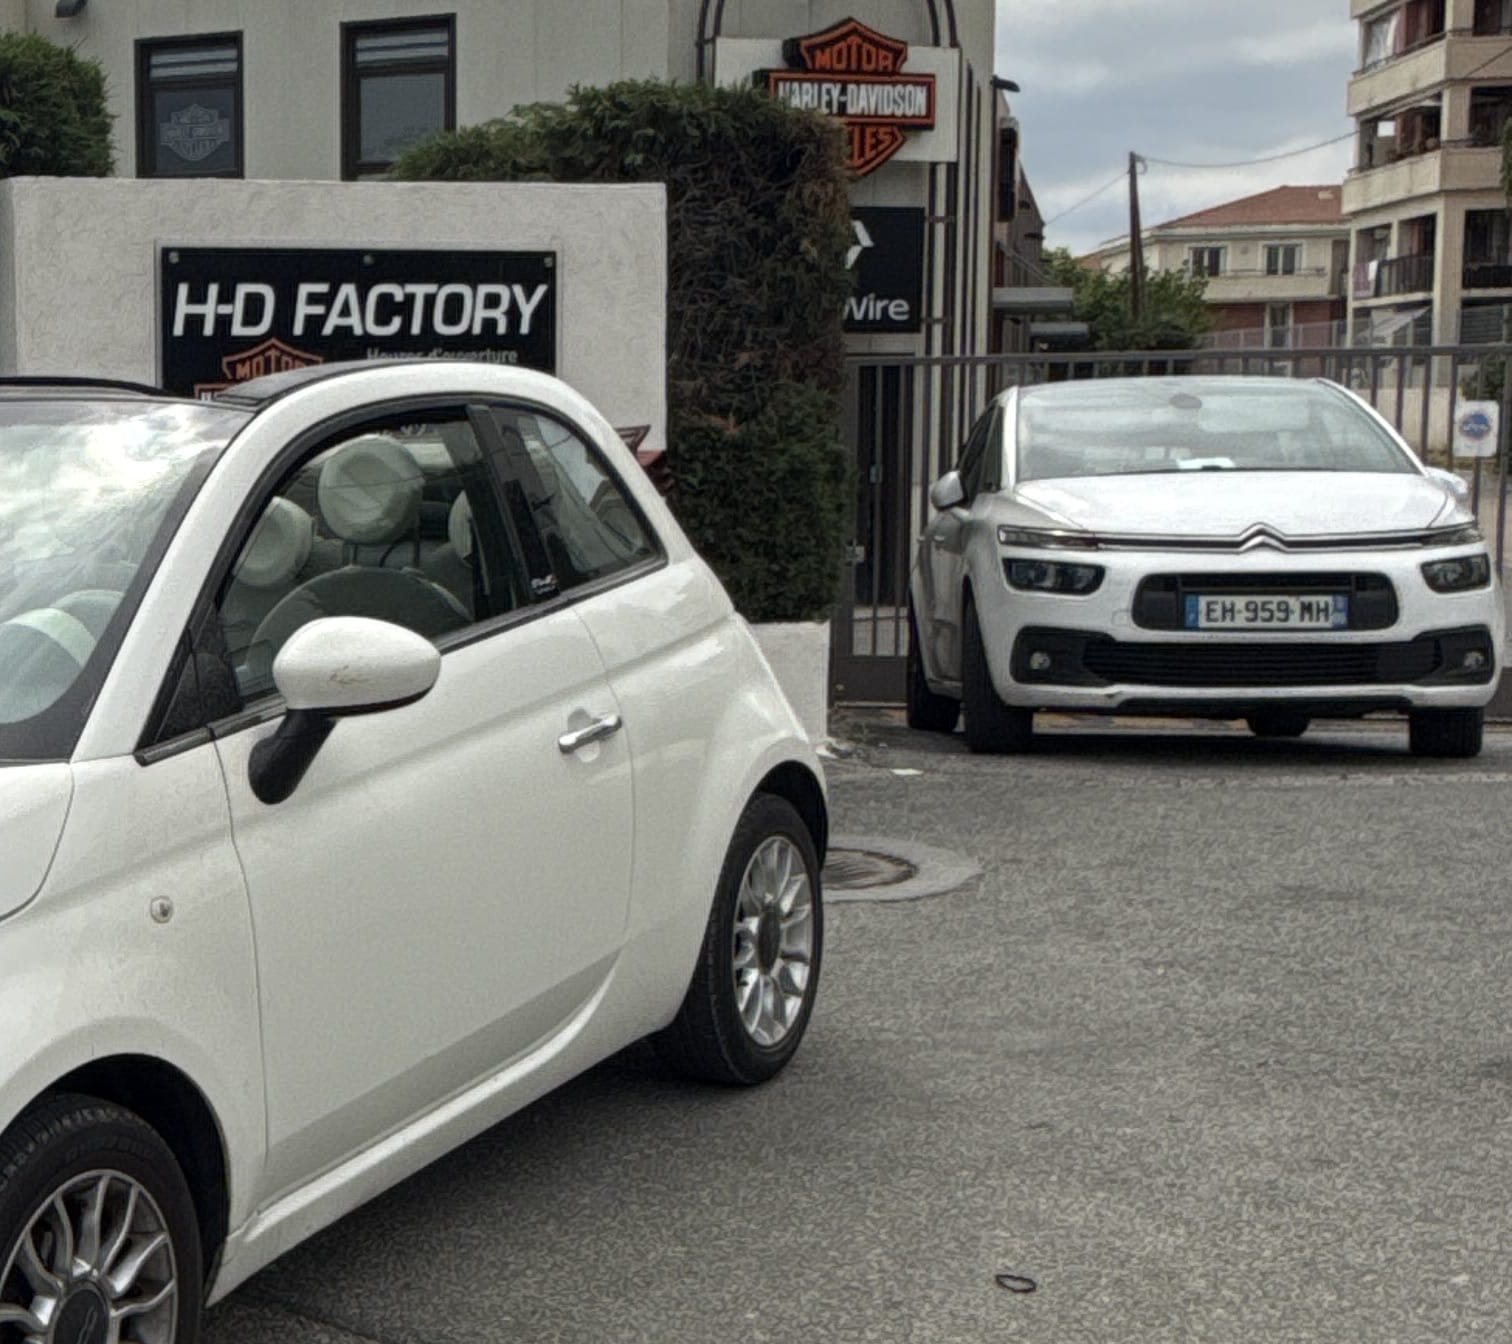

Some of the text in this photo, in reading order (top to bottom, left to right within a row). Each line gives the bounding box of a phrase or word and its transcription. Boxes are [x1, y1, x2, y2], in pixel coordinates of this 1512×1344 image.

[814, 36, 894, 73] MOTOR
[777, 81, 928, 117] HARLEY-DAVIDSON
[172, 282, 549, 337] H-D FACTORY
[842, 291, 910, 321] Wire
